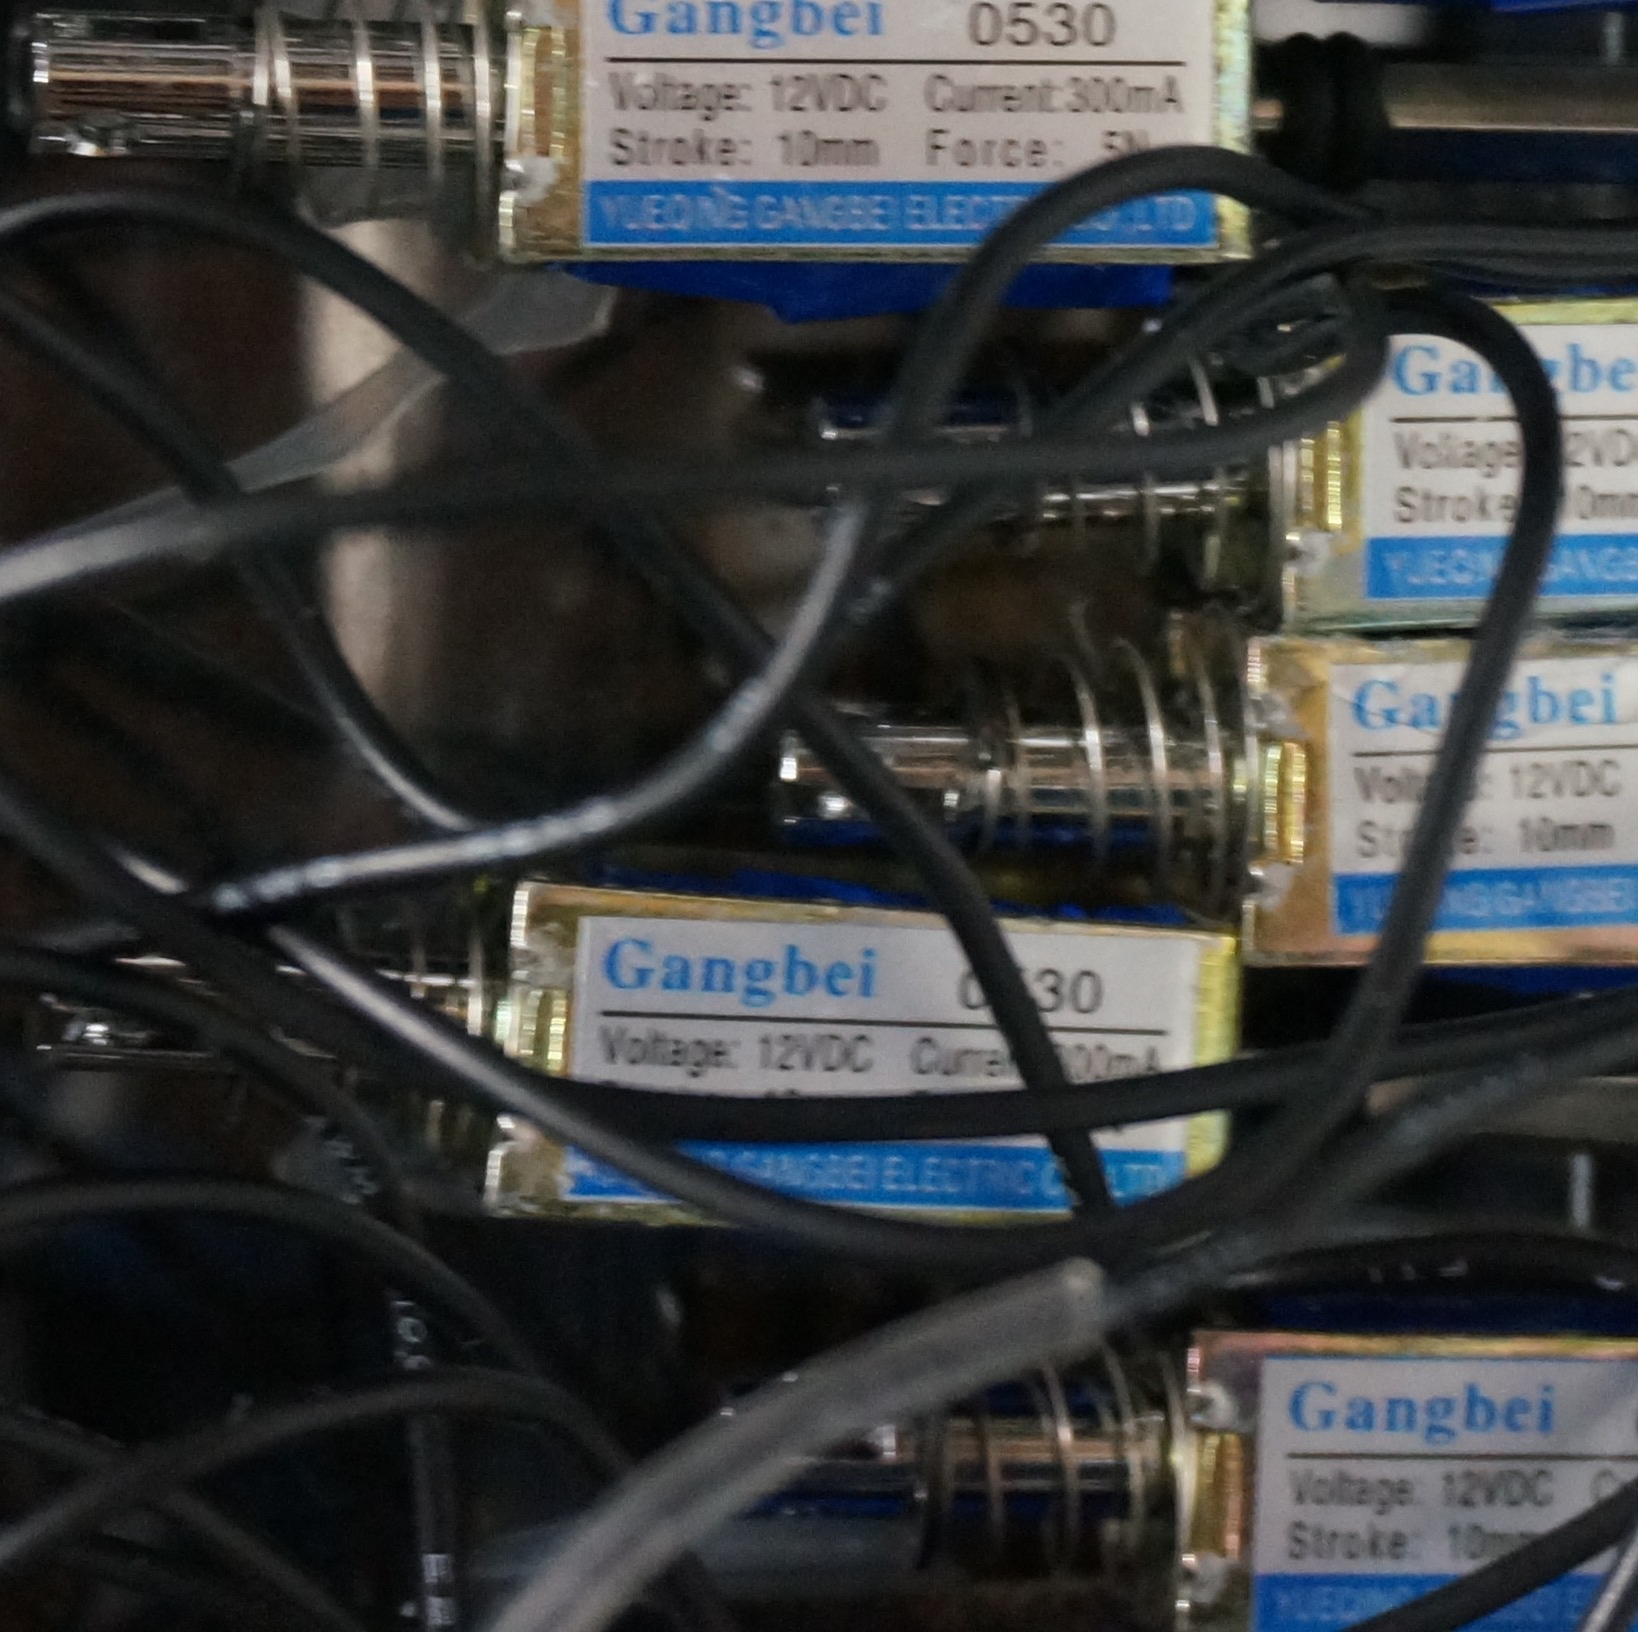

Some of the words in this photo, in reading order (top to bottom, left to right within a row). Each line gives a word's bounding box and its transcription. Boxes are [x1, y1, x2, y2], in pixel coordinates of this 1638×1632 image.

[967, 0, 1119, 49] 0530
[607, 70, 754, 123] Voltage:
[768, 72, 890, 115] 12VDC
[607, 127, 754, 169] Stroke:
[776, 129, 882, 169] 10mm
[925, 128, 1065, 168] Force:
[1509, 757, 1624, 801] 12VDC
[1518, 815, 1617, 854] 10mm
[601, 936, 879, 1008] Gangbei
[956, 967, 1106, 1017] 030
[600, 1022, 742, 1079] Voltage:
[757, 1031, 875, 1074] 12VDC
[1288, 1379, 1557, 1445] Gangbei
[1289, 1467, 1422, 1516] Voltage:
[1442, 1468, 1555, 1510] 12VDC
[1288, 1520, 1423, 1563] Stroke:
